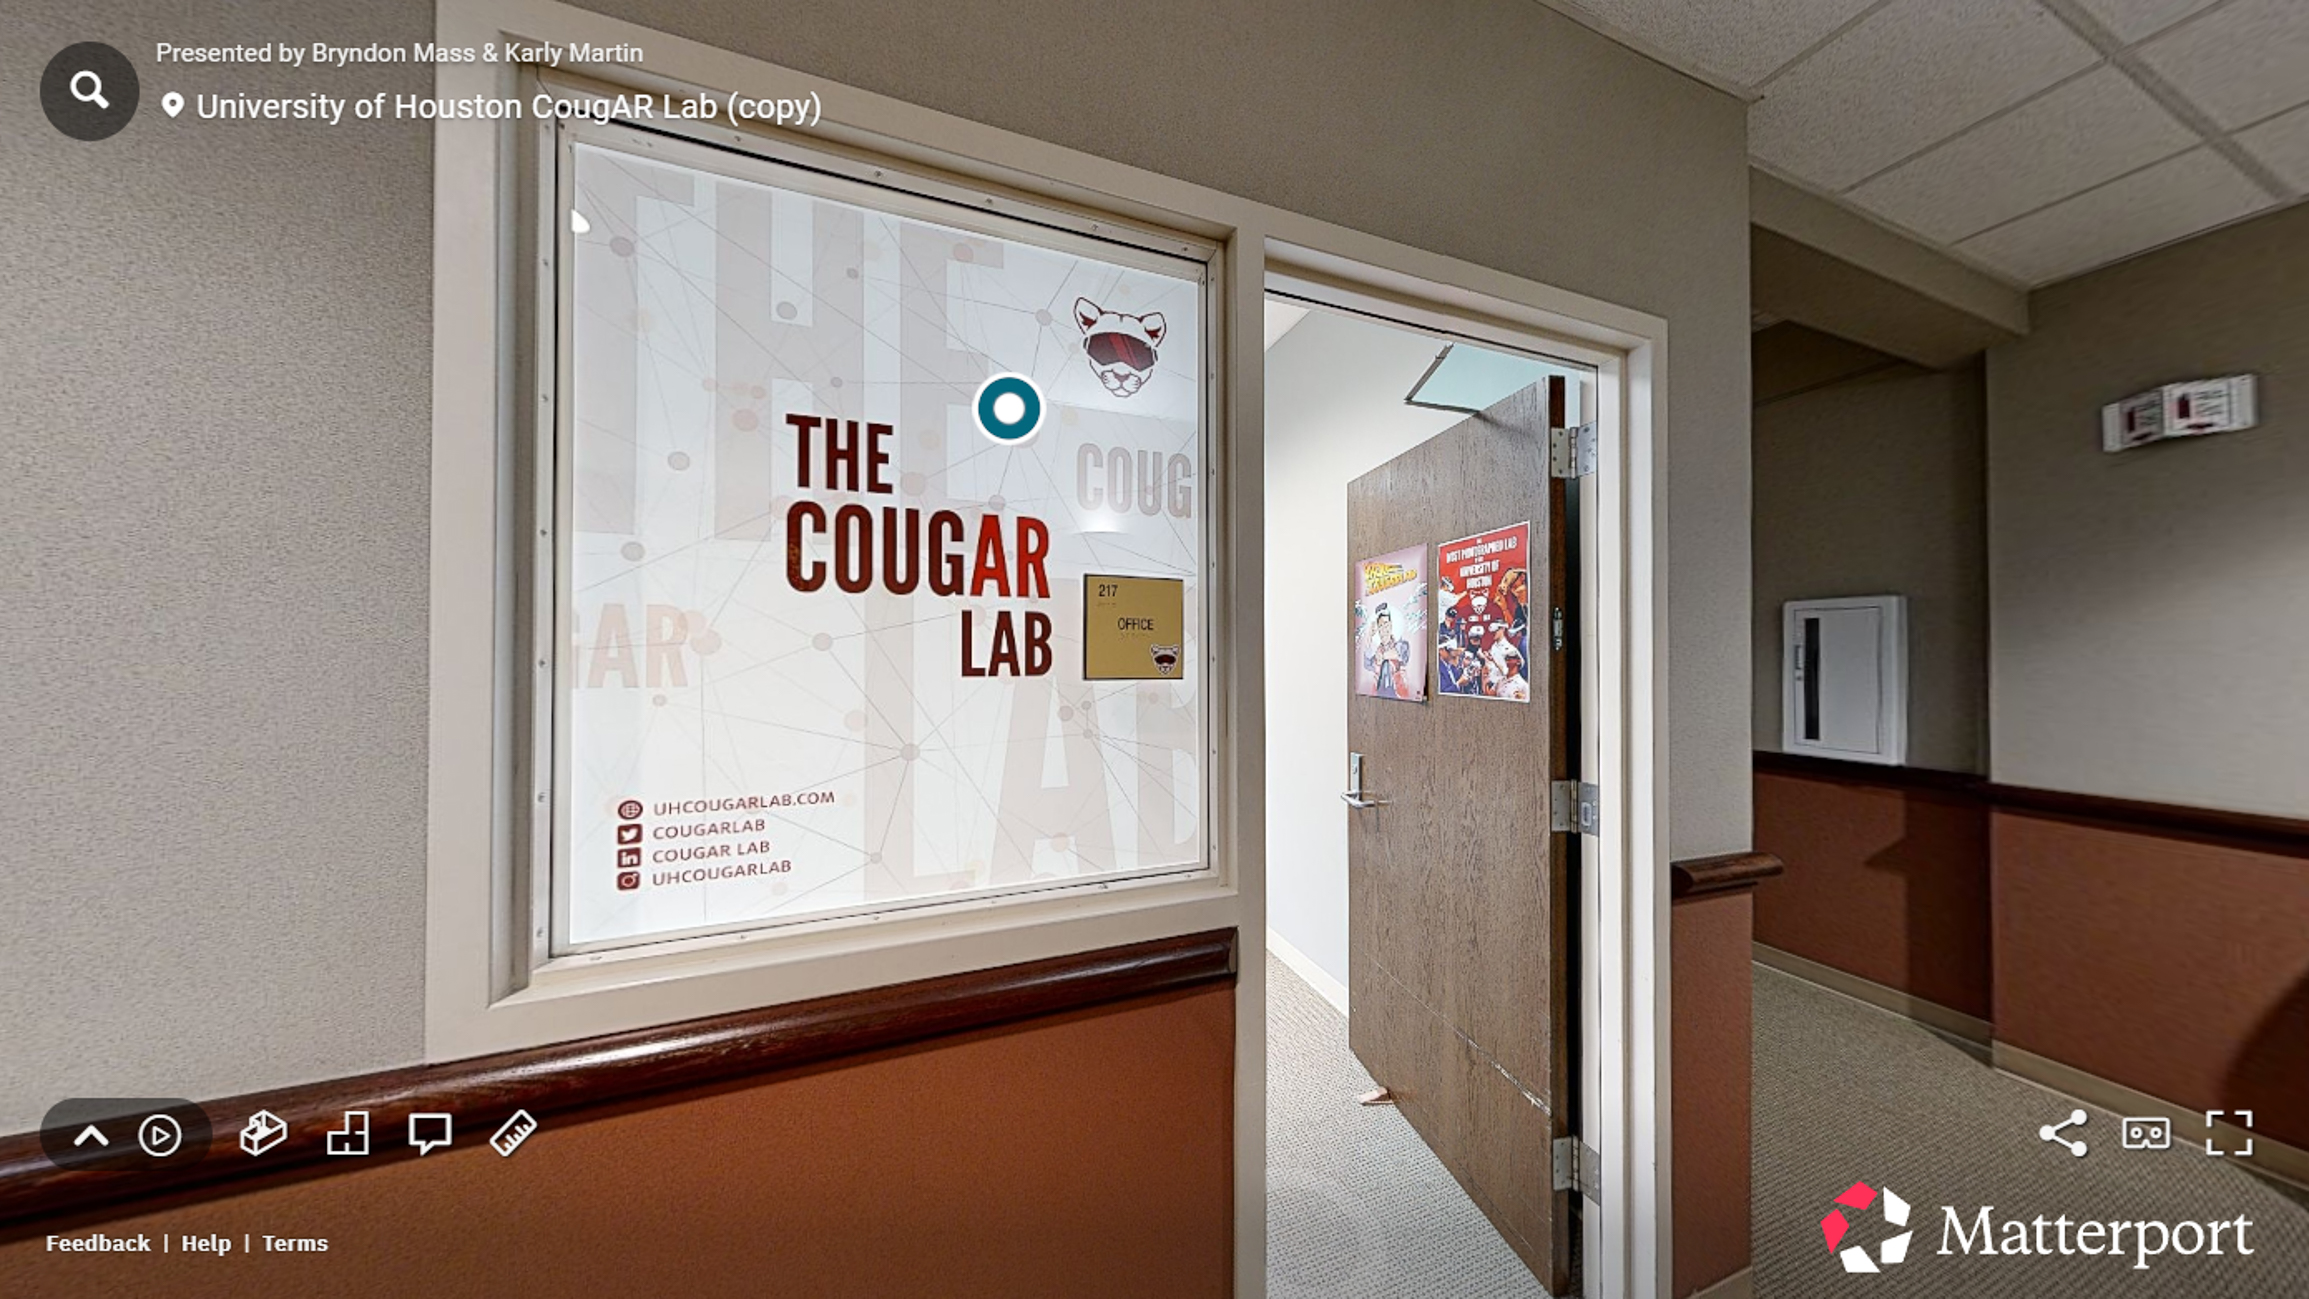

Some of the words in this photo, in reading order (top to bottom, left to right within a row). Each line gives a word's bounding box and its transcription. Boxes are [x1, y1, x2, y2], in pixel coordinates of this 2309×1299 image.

[786, 413, 893, 494] THE
[787, 500, 1050, 599] COUGAR
[1098, 584, 1118, 597] 217
[1117, 617, 1154, 631] OFFICE
[572, 603, 688, 688] AR
[961, 610, 1052, 677] LAB
[653, 791, 835, 816] UHCOUGARLAB.COM
[653, 818, 766, 839] COUGARLAB
[652, 844, 731, 863] COUGAR
[737, 840, 771, 856] LAB
[652, 859, 792, 886] UHCOUGARLAB
